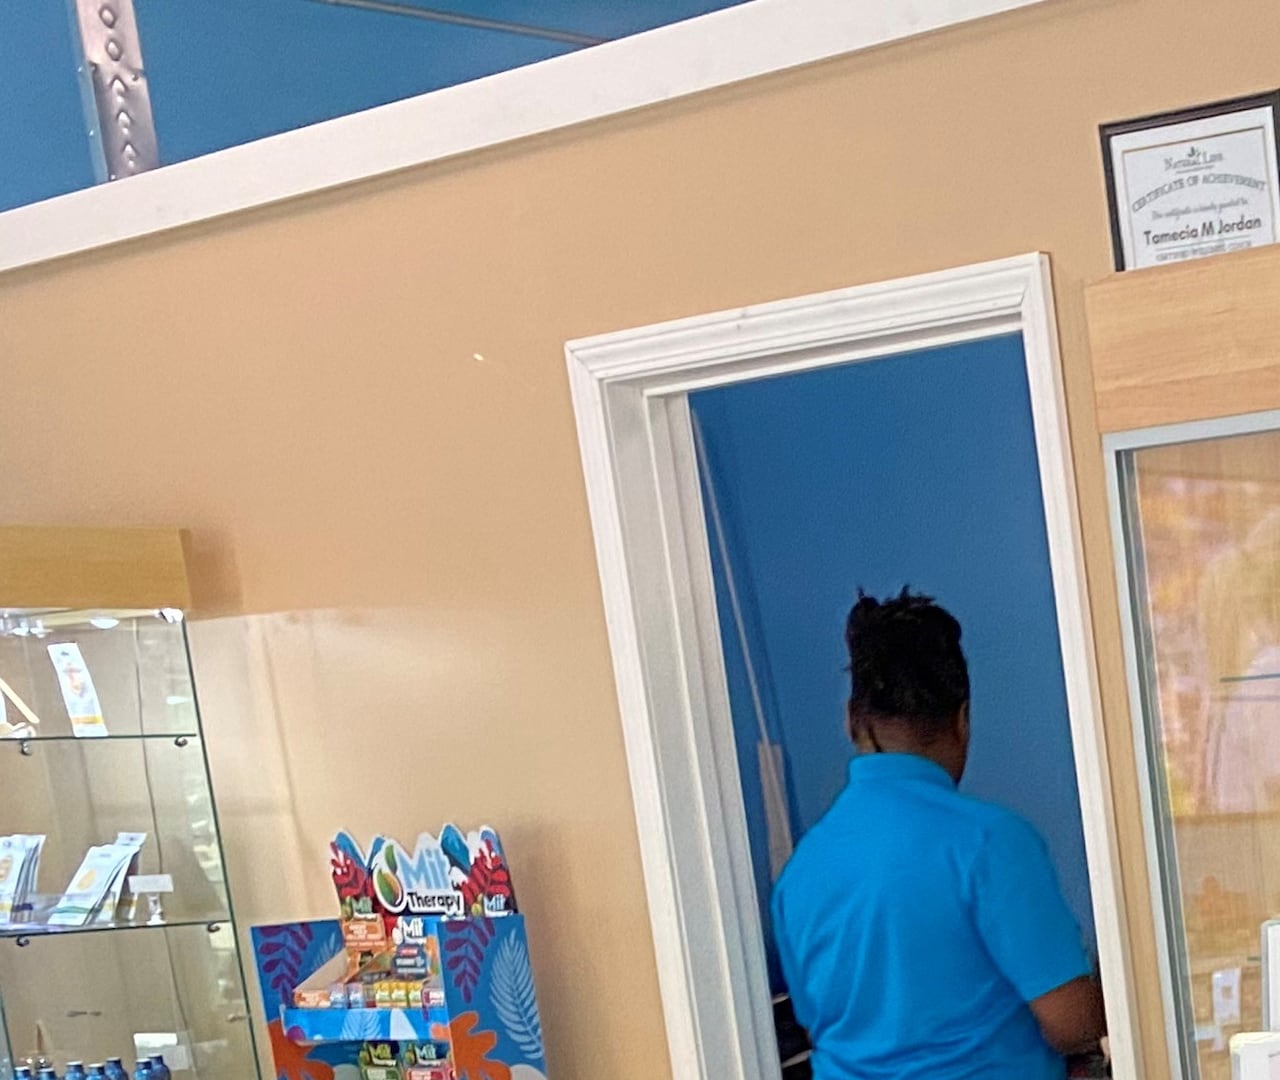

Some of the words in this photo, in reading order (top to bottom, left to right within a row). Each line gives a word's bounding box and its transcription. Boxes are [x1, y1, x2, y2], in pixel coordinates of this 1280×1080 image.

[1187, 178, 1199, 188] OF
[1144, 224, 1199, 245] Tamecia
[1201, 221, 1215, 236] M
[1218, 214, 1262, 235] Jordan
[408, 891, 462, 912] Therapy
